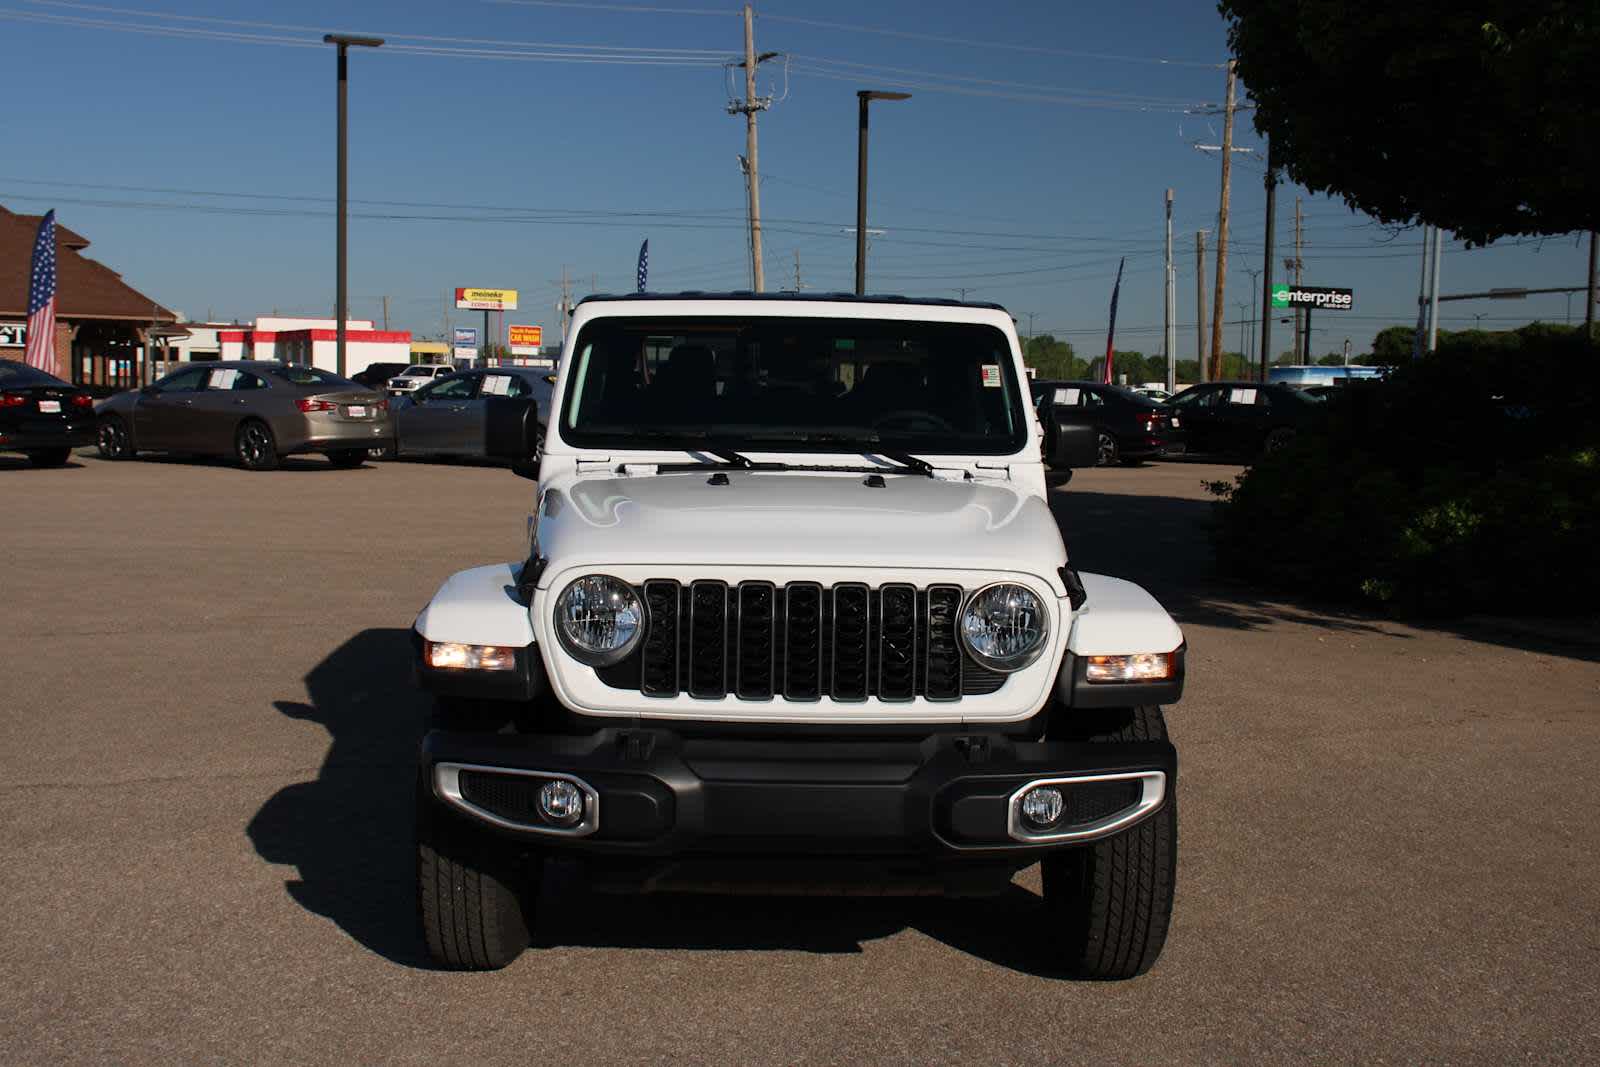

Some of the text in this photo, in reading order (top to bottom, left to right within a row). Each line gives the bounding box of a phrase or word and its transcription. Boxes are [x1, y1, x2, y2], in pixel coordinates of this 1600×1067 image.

[1273, 290, 1352, 306] enterprise
[511, 334, 540, 342] CAR WASH
